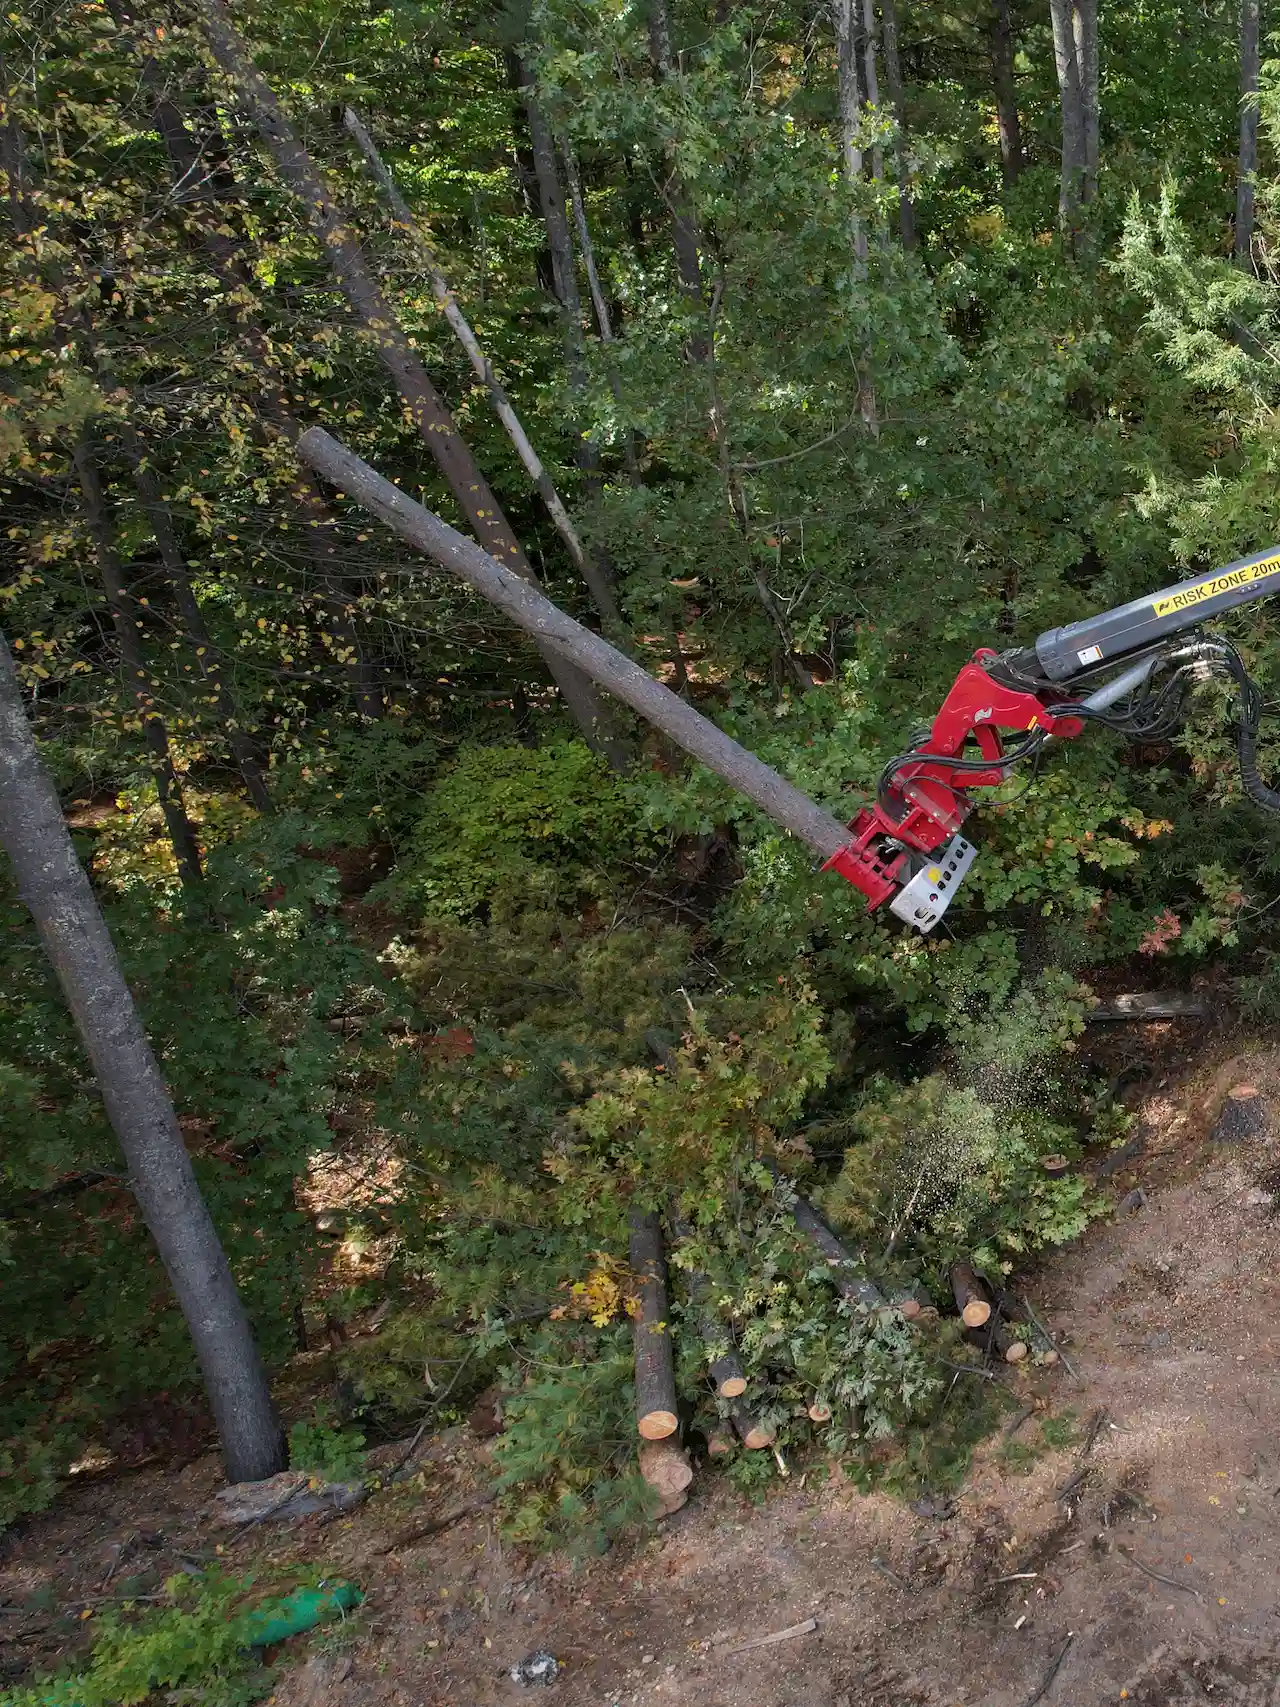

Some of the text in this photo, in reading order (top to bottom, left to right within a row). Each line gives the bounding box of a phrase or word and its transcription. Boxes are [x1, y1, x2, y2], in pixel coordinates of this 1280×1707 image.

[1172, 560, 1280, 608] RISK ZONE 20m
